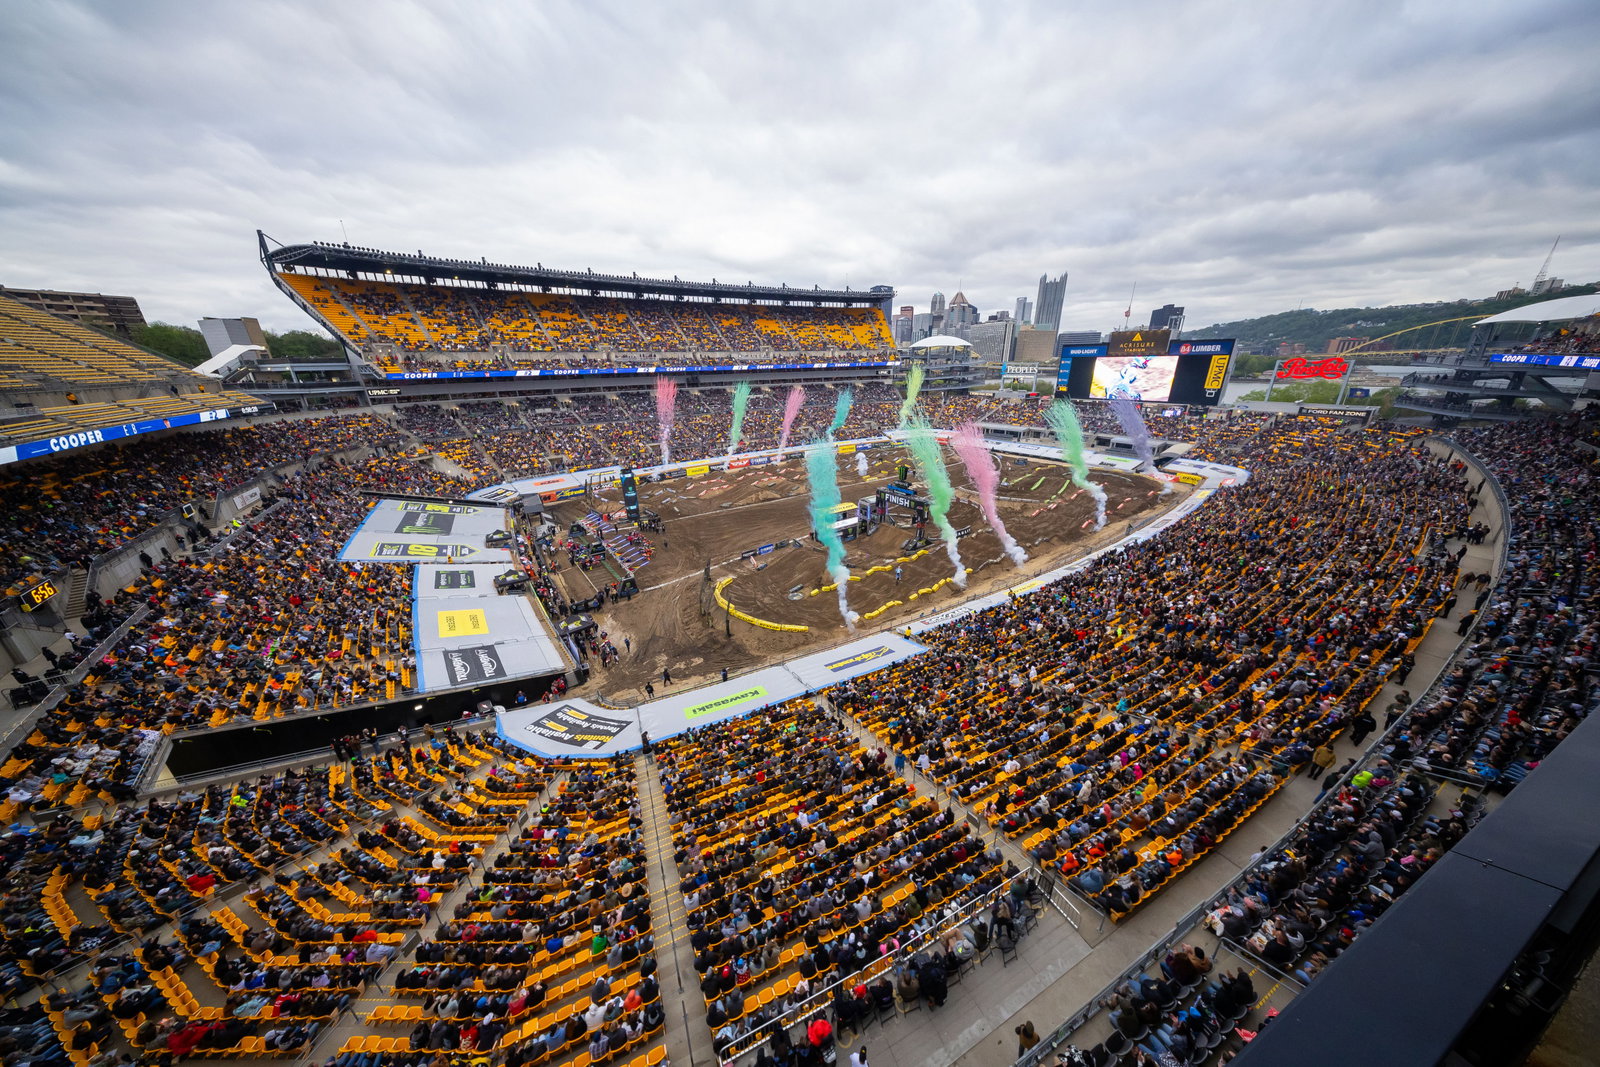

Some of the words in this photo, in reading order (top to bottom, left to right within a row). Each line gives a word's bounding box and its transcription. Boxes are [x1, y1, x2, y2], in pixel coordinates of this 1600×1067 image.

[1192, 344, 1221, 352] LUMBER
[1210, 357, 1226, 387] UPMC
[50, 430, 104, 452] COOPER
[885, 493, 910, 508] FINISH
[31, 582, 54, 603] 6:56
[449, 652, 470, 682] TRIUMPH
[475, 649, 497, 678] TRIUMPH
[692, 689, 760, 714] Kawasaki
[556, 712, 591, 728] Available
[526, 724, 575, 741] Available
[574, 734, 614, 743] Rentals
